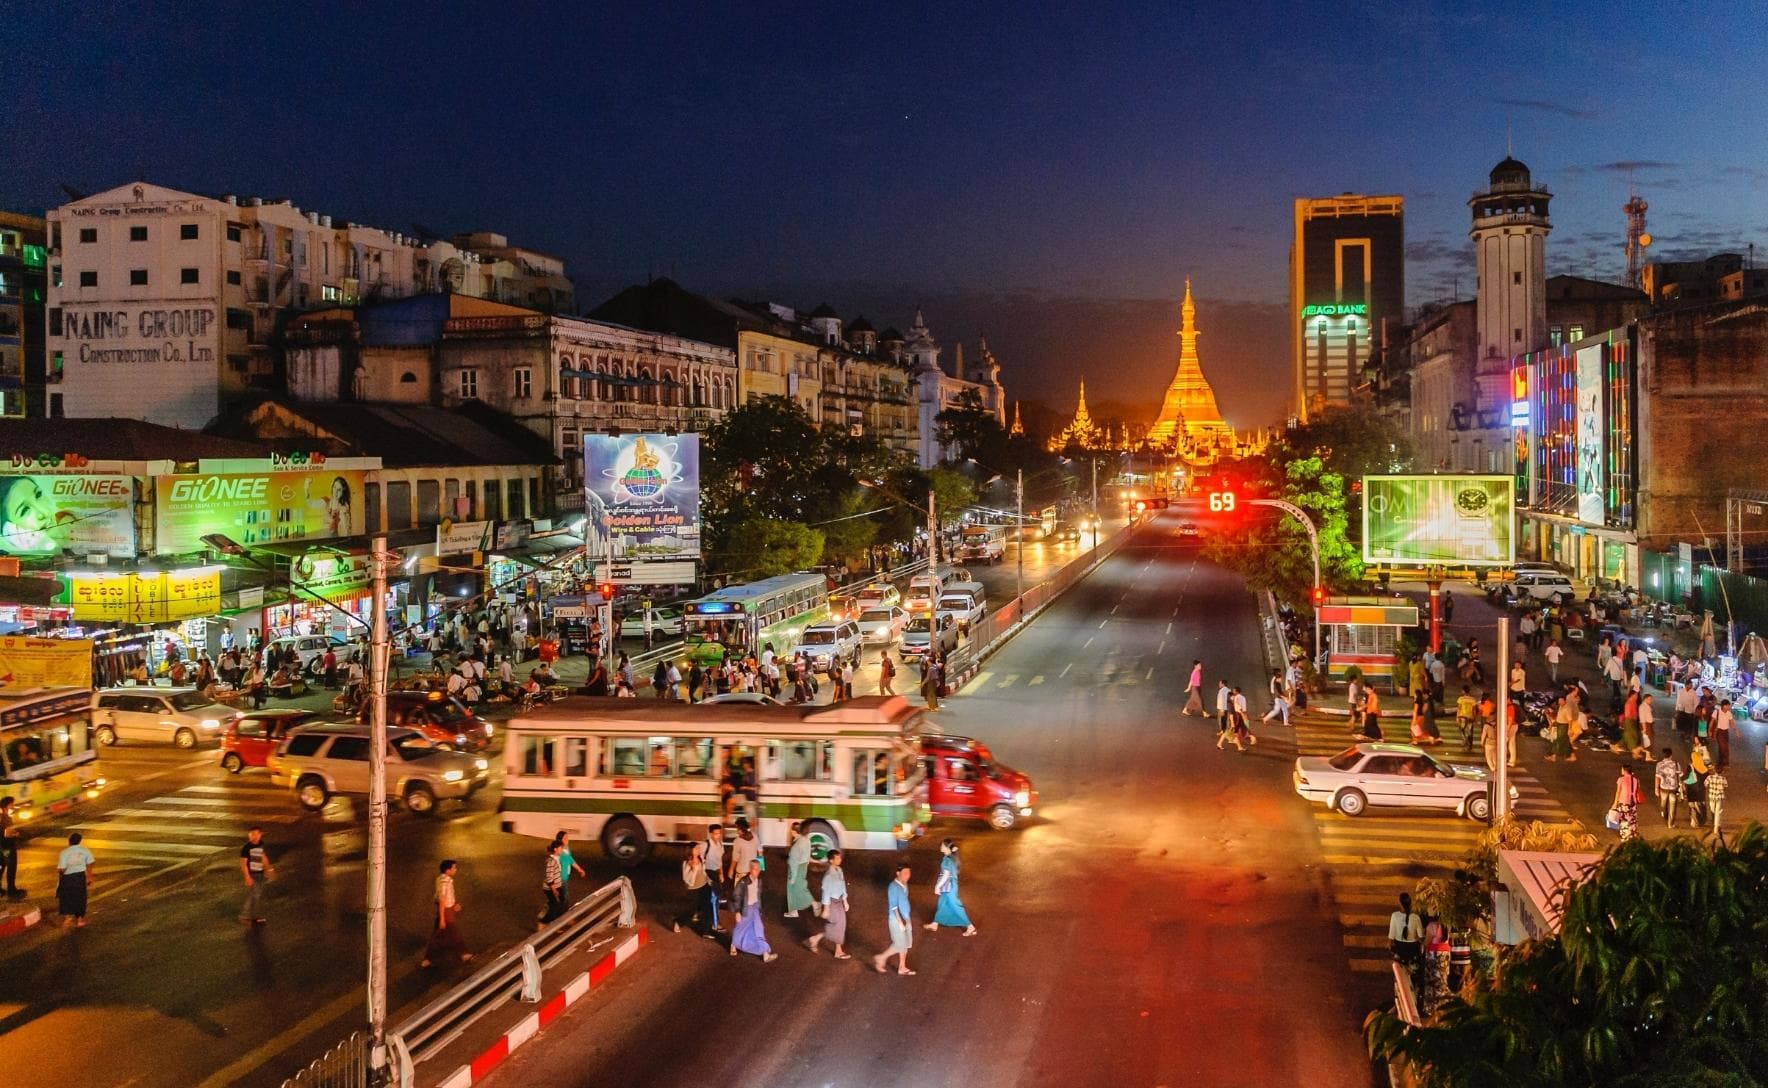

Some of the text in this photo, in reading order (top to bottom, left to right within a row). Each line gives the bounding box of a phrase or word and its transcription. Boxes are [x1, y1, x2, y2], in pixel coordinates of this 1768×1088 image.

[71, 208, 96, 217] NAING
[1337, 304, 1367, 315] BANK
[65, 308, 215, 340] NAING GROUP
[1209, 492, 1235, 512] 69
[603, 513, 684, 526] Golden Lion
